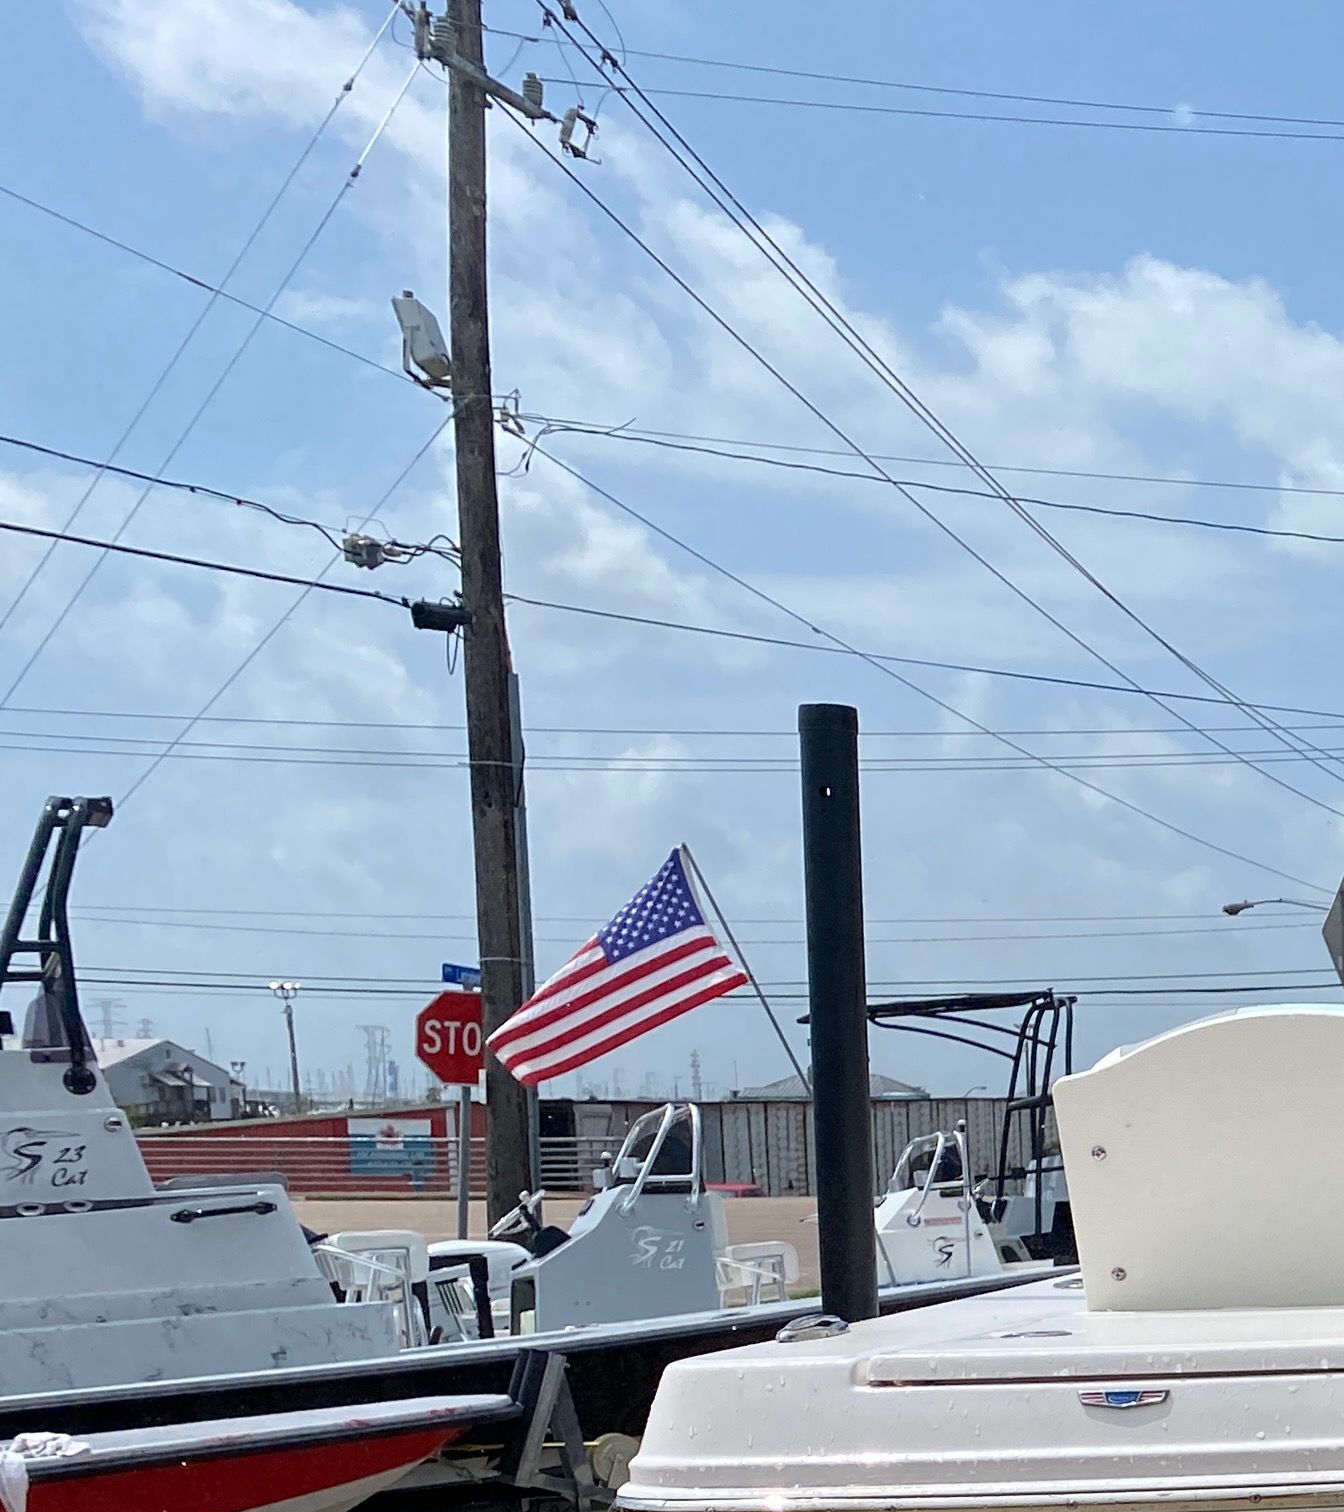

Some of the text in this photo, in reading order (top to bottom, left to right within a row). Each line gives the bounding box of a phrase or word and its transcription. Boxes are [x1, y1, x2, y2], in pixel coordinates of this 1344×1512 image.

[422, 1019, 482, 1057] STO
[52, 1145, 87, 1164] 23
[51, 1167, 88, 1187] Cat
